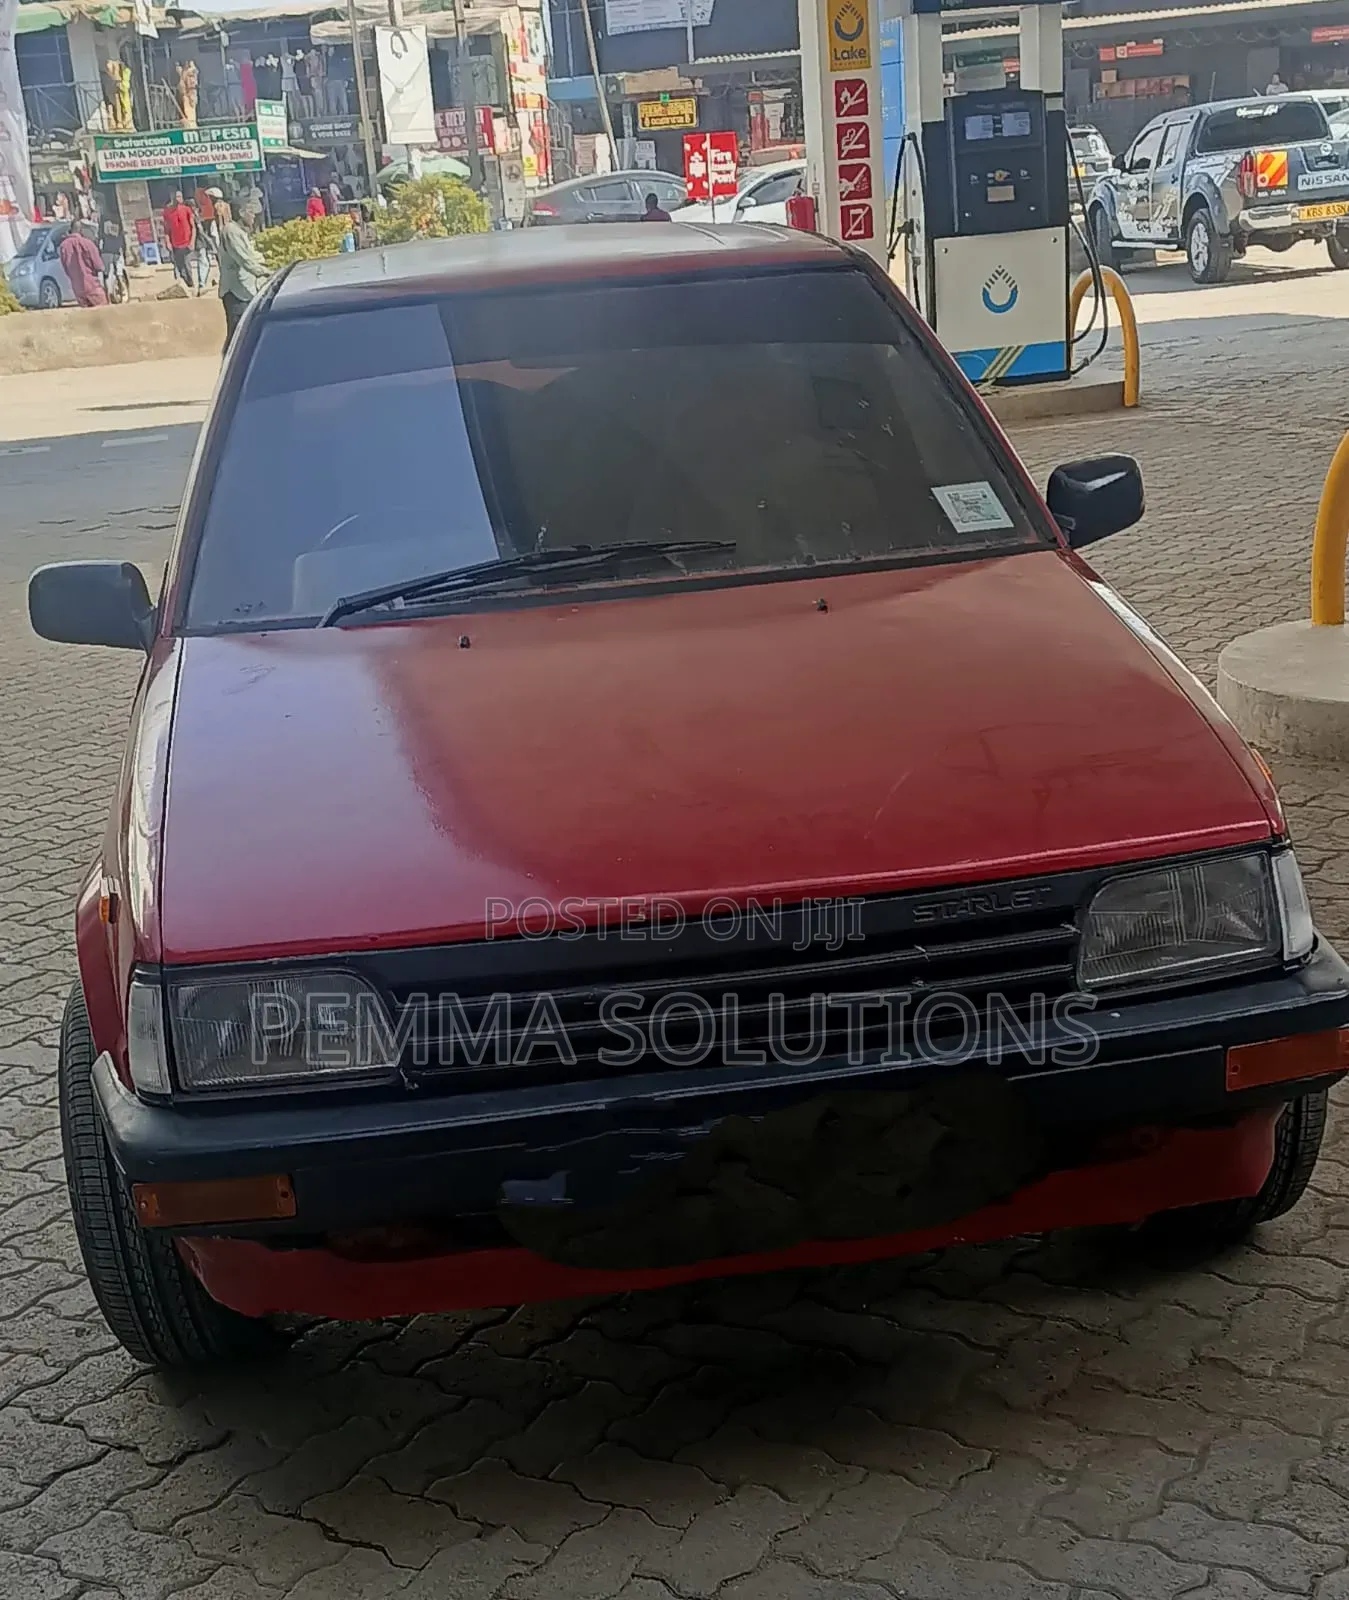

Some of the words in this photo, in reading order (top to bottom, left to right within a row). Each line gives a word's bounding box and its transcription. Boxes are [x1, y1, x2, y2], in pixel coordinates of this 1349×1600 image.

[833, 46, 867, 61] Lake
[113, 137, 172, 149] Safaricom
[104, 150, 126, 160] LIPA
[210, 141, 253, 152] PHONES
[710, 149, 732, 161] Fire
[105, 160, 140, 169] PHONE
[140, 157, 176, 167] REPAIR
[1301, 174, 1349, 186] NISSAN
[1306, 206, 1323, 218] KBS
[912, 885, 1052, 923] STARLET
